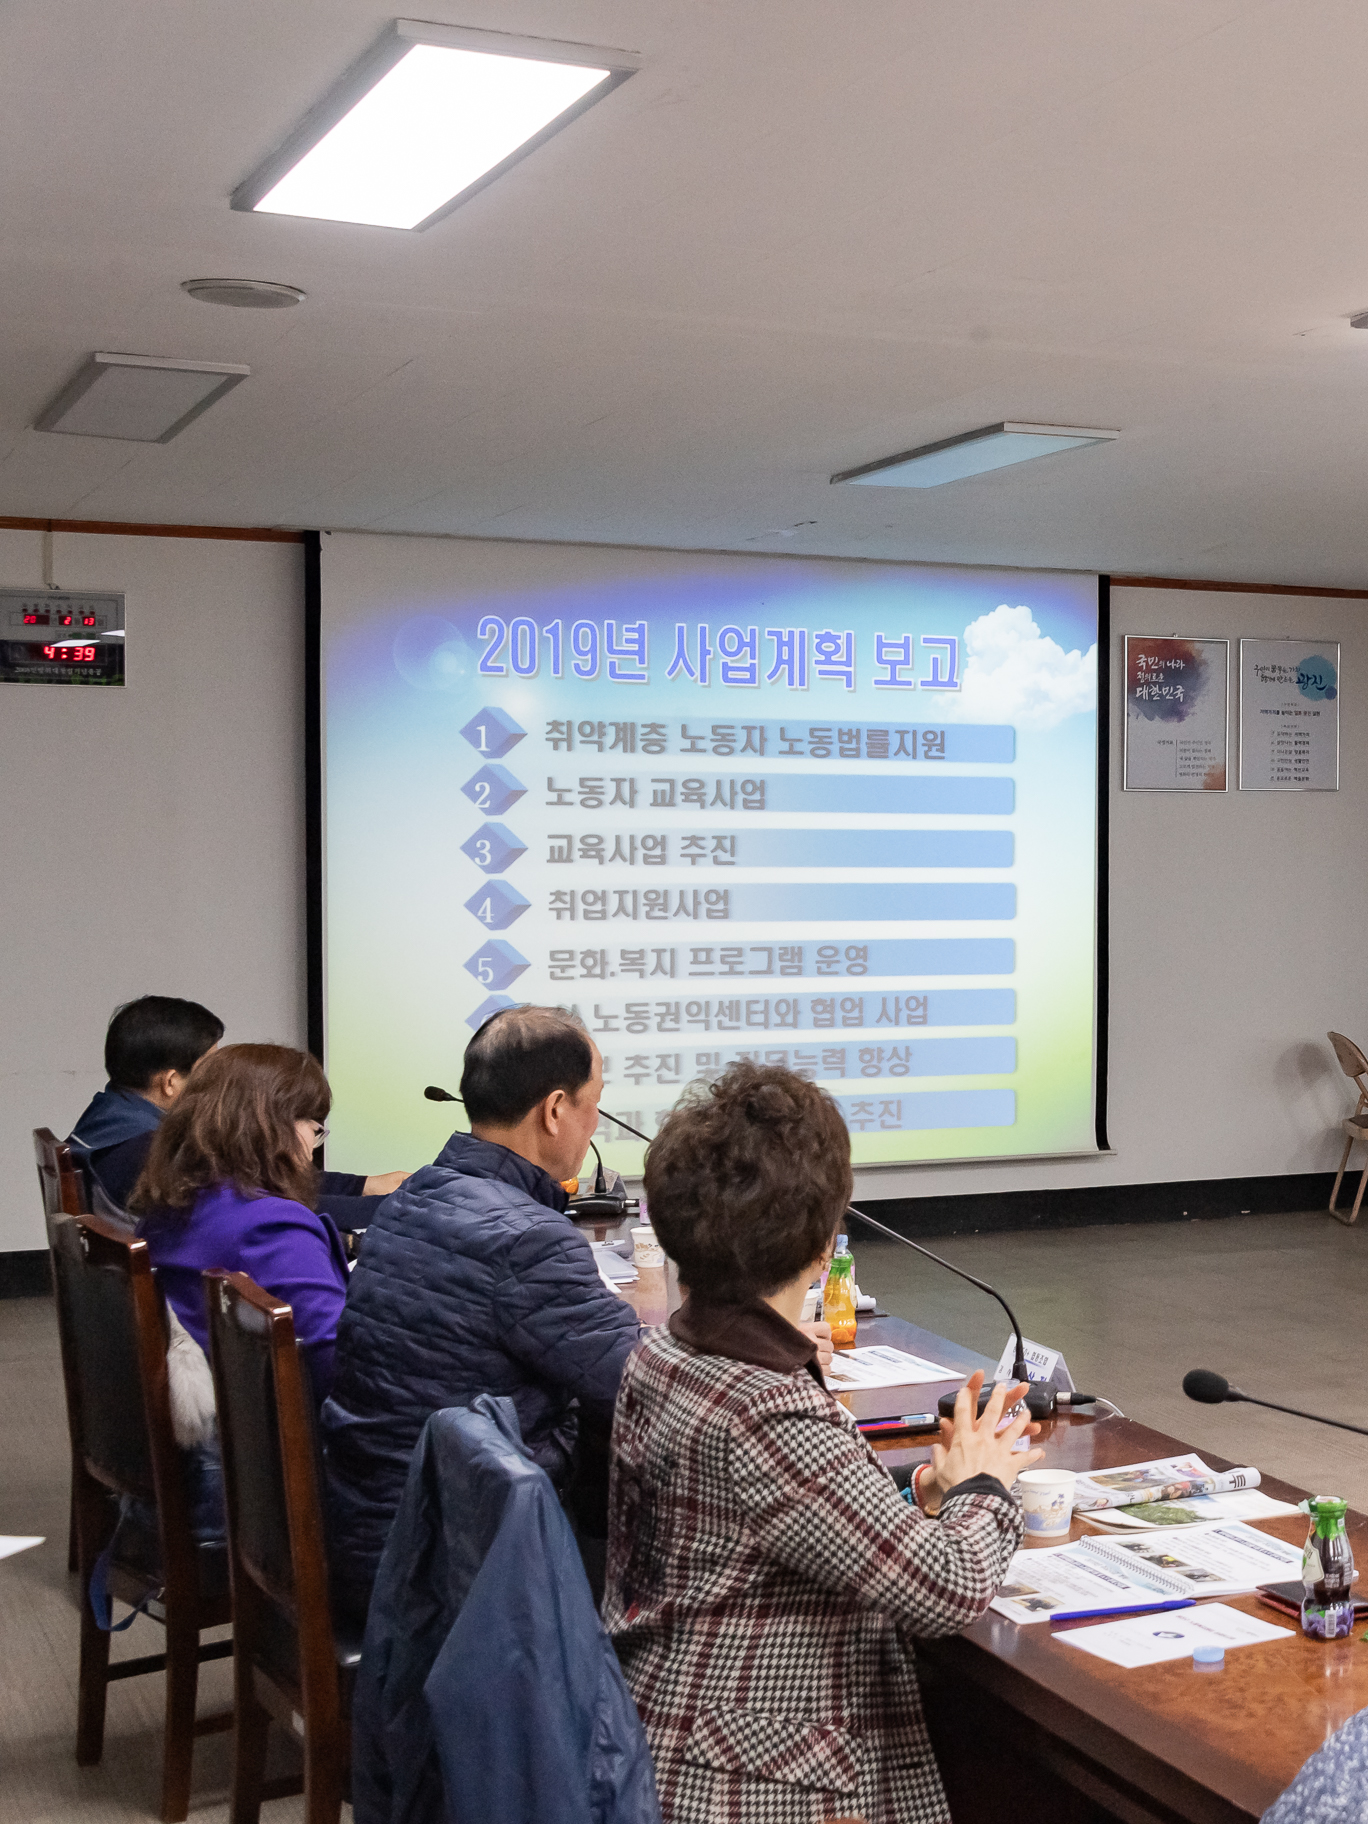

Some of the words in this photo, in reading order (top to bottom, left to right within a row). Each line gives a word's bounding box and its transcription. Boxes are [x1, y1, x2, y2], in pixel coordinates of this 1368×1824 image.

[477, 615, 650, 684] 2019년
[664, 622, 855, 690] 사업계획
[872, 631, 961, 690] 보고
[1166, 659, 1186, 670] 나라
[1135, 684, 1185, 703] 대한민국
[1295, 672, 1328, 691] 광진
[475, 725, 491, 752] 1
[545, 719, 668, 755] 취약계층
[679, 723, 768, 757] 노동자
[778, 726, 947, 761] 노동법률지원
[474, 782, 492, 809] 2
[545, 776, 639, 809] 노동자
[649, 778, 767, 811] 교육사업
[474, 839, 493, 866] 3
[545, 834, 668, 866] 교육사업
[679, 835, 737, 866] 추진
[476, 897, 495, 924] 4
[547, 889, 731, 921] 취업지원사업
[477, 957, 495, 984] 5
[547, 948, 677, 981] 문화.복지
[688, 945, 804, 977] 프로그램
[815, 945, 870, 977] 운영
[592, 998, 802, 1034] 노동권익센터와
[810, 997, 865, 1029] 협업
[875, 995, 929, 1026] 사업
[623, 1053, 681, 1086] 추진
[857, 1046, 914, 1078] 향상
[850, 1098, 903, 1131] 추진
